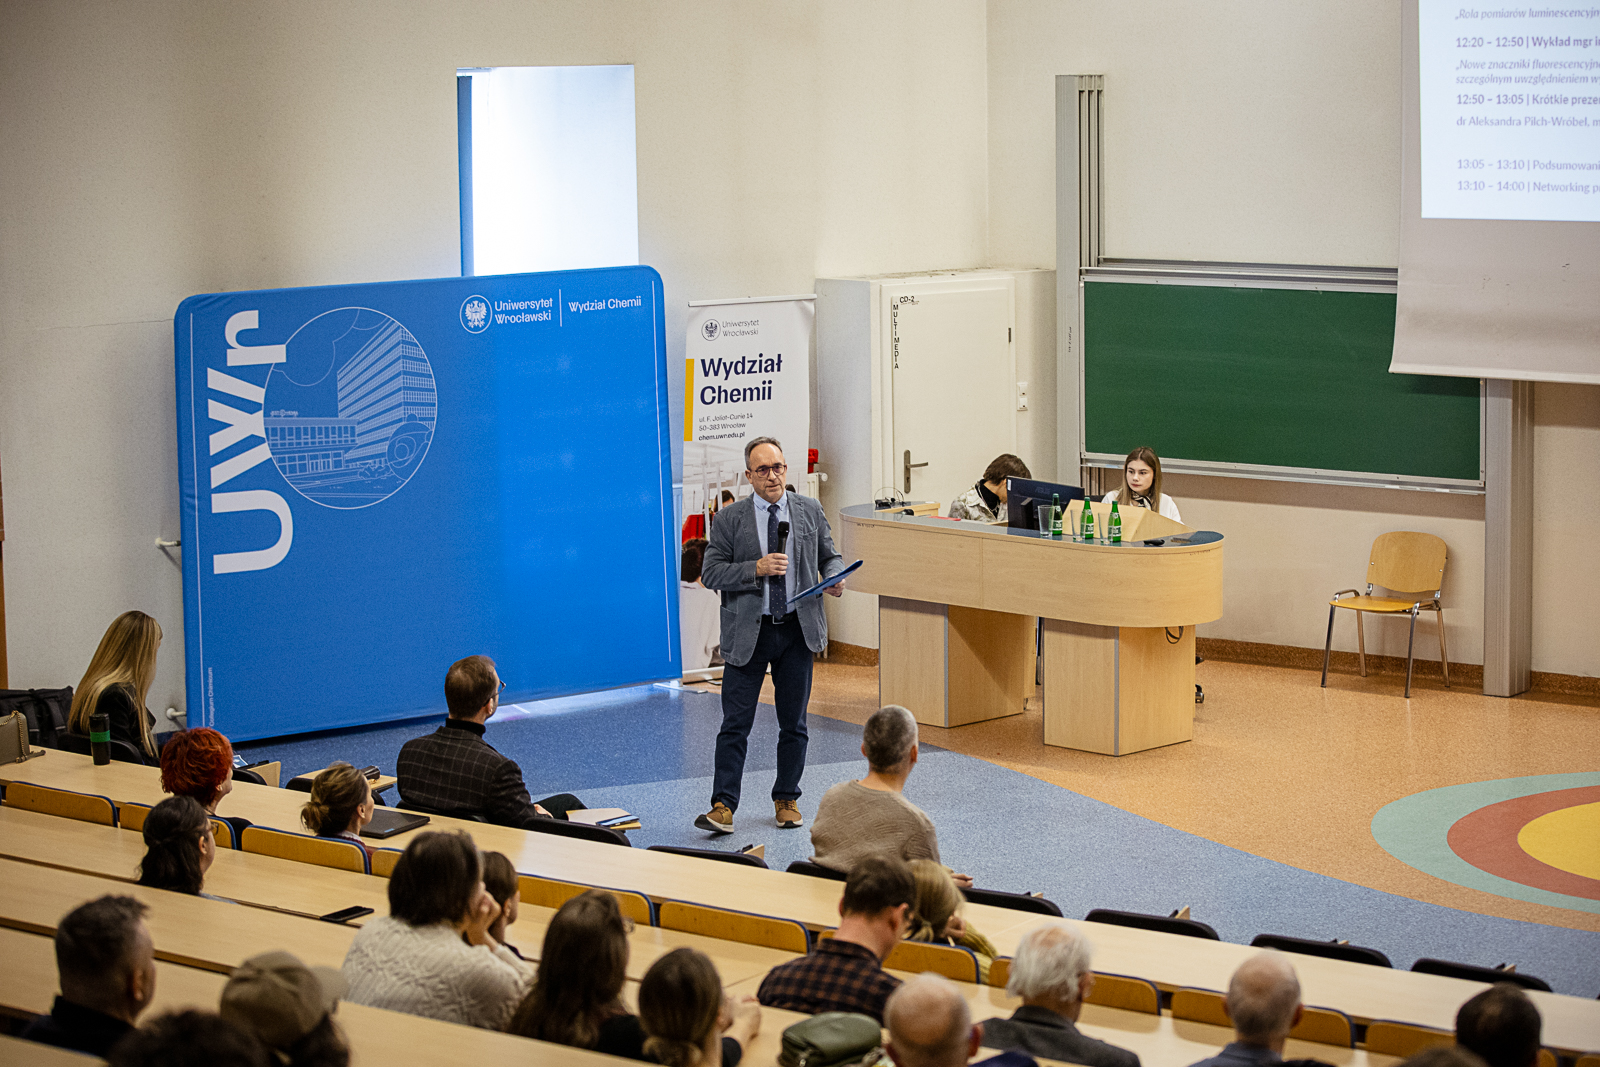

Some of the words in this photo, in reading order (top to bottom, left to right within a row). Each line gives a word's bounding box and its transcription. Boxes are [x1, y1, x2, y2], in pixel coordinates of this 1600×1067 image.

[1481, 8, 1527, 20] pomiarów
[1456, 37, 1484, 47] 12:20
[1495, 36, 1524, 47] 12:50
[1531, 36, 1571, 48] Wykład
[1573, 39, 1593, 48] mgr
[1488, 59, 1531, 69] znaczniki
[1456, 74, 1512, 85] szczególnym
[1514, 73, 1588, 85] uwzględnieniem
[1457, 94, 1484, 104] 12:50
[1496, 94, 1524, 104] 13:05
[1532, 94, 1569, 104] Krótkie
[1571, 96, 1600, 106] preze
[1456, 116, 1467, 126] dr
[1469, 116, 1522, 126] Aleksandra
[1524, 116, 1590, 127] Pilch-Wróbel,
[1457, 159, 1484, 169] 13:05
[1497, 159, 1524, 170] 13:10
[1458, 181, 1485, 191] 13:10
[1497, 181, 1524, 191] 14:00
[1533, 182, 1590, 194] Networking
[495, 298, 553, 311] Uniwersytet
[568, 300, 606, 313] Wydział
[608, 296, 642, 309] Chemii
[495, 310, 552, 324] Wrocławski
[722, 319, 759, 328] Uniwersytet
[722, 328, 759, 337] Wrocławski
[700, 353, 782, 380] Wydział
[700, 380, 772, 405] Chemii
